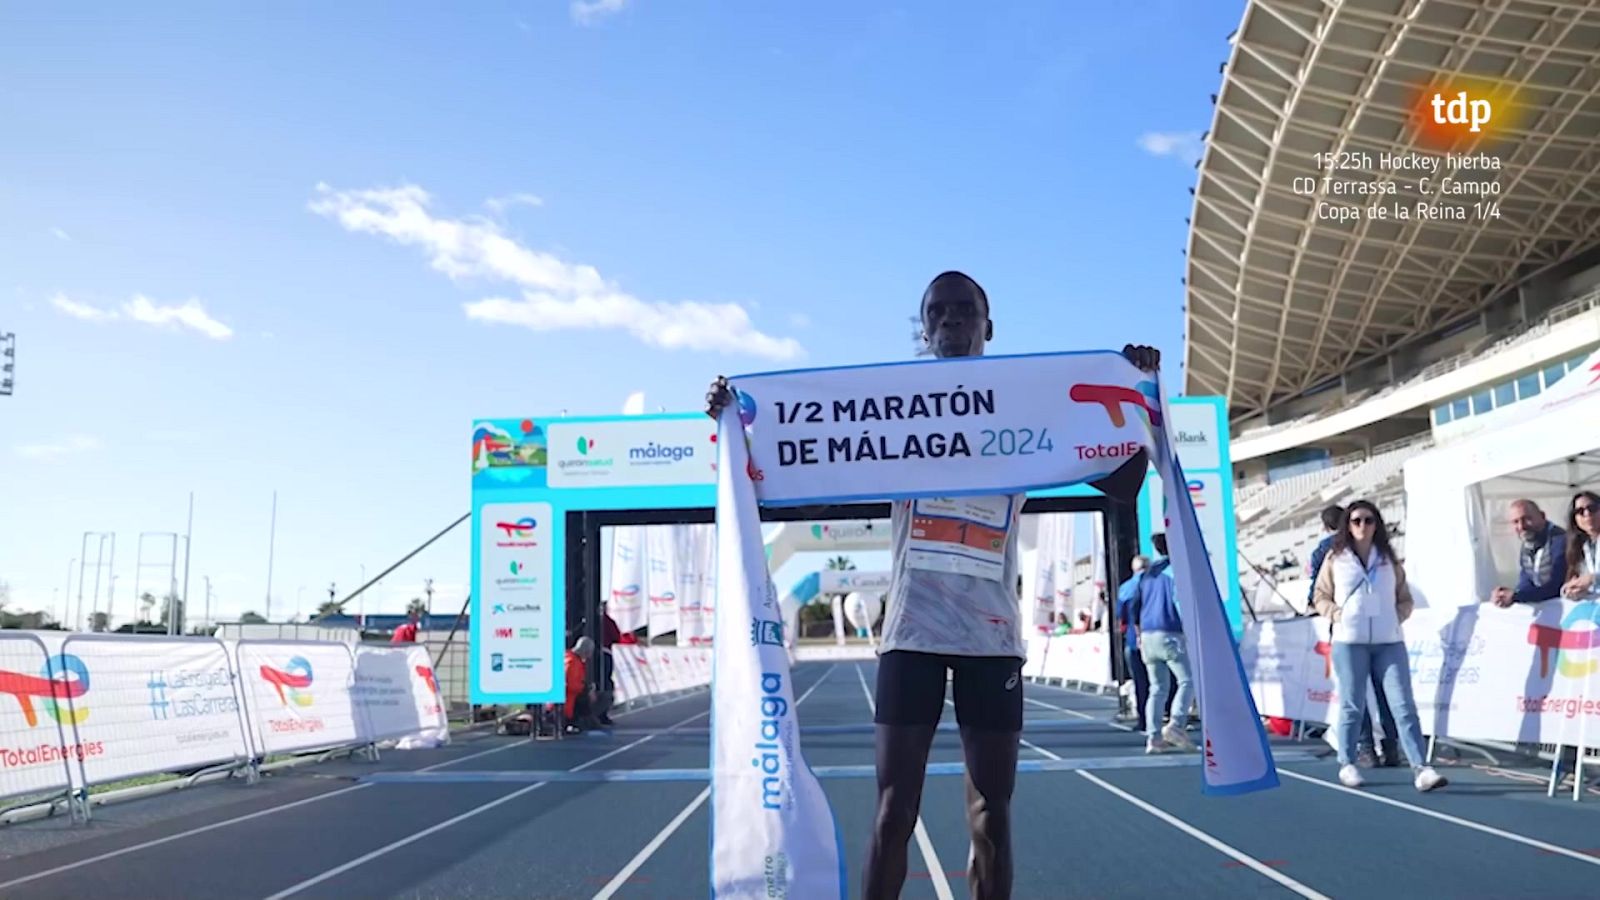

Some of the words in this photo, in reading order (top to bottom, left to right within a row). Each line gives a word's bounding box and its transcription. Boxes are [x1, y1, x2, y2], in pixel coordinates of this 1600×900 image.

[774, 401, 824, 425] 1/2
[832, 384, 995, 423] MARATÓN
[777, 438, 819, 466] DE
[827, 430, 972, 463] MÁLAGA
[980, 427, 1054, 457] 2024
[0, 740, 104, 767] TotalEnergies
[752, 672, 788, 810] málaga
